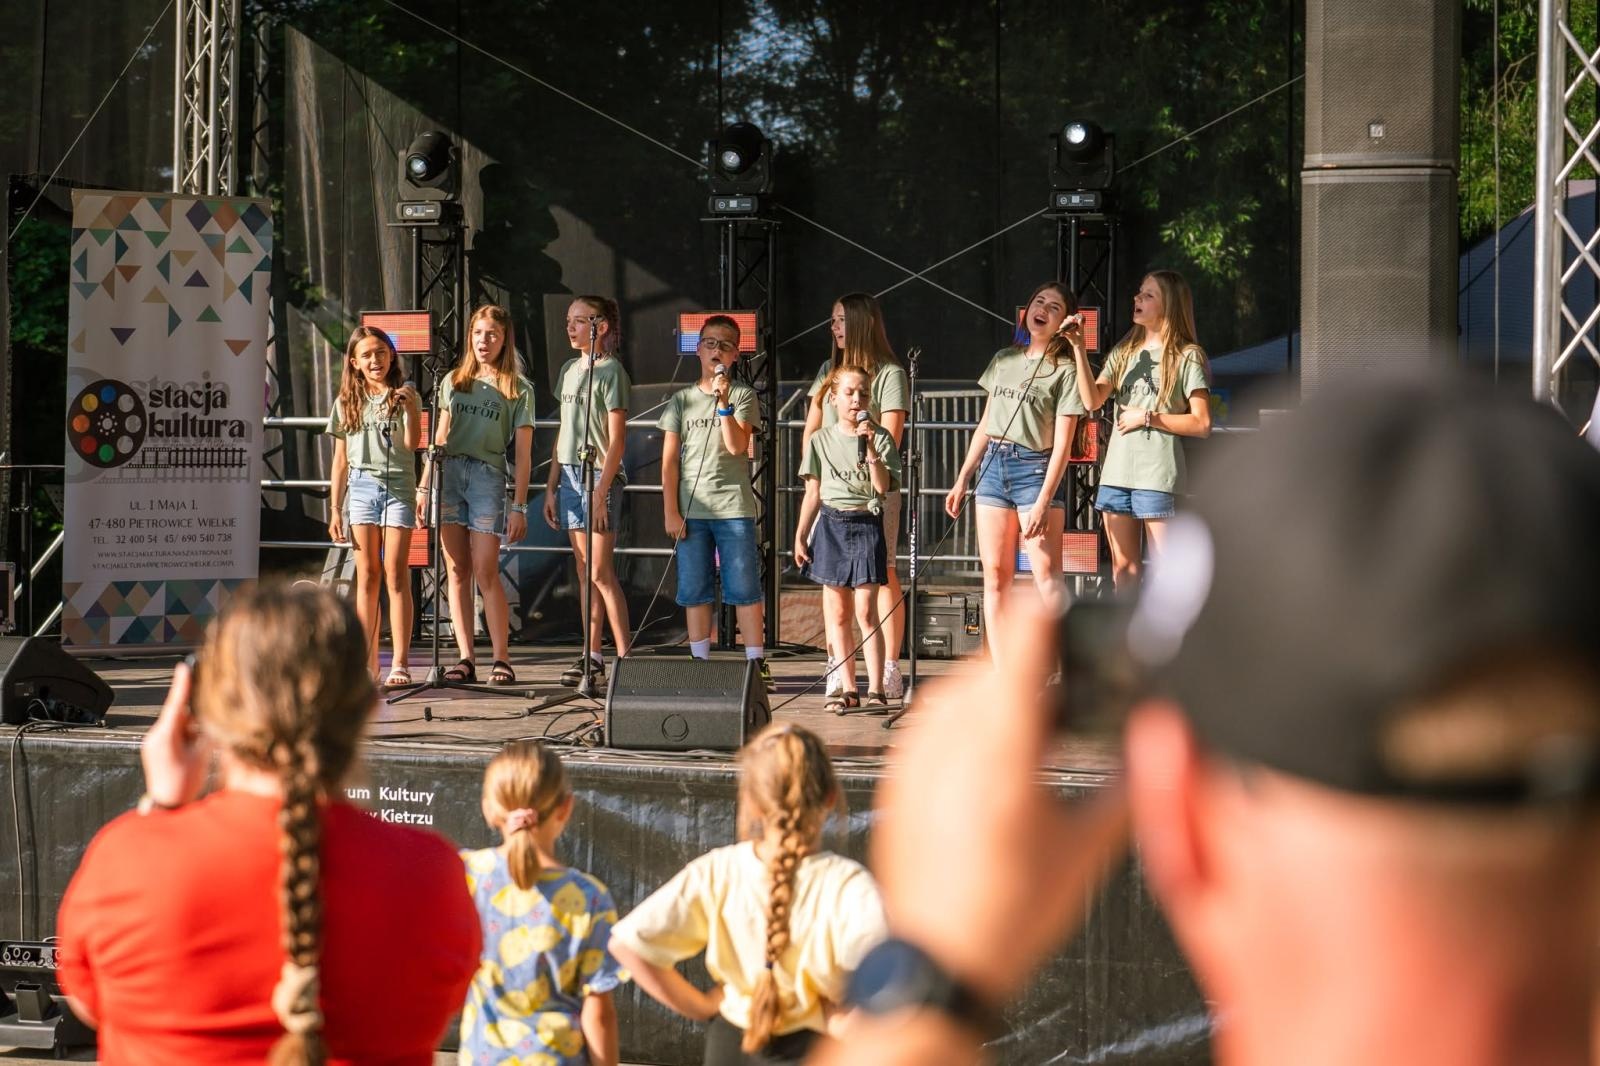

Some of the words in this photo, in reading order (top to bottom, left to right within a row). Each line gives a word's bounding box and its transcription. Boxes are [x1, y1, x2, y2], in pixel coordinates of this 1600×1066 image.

[149, 382, 227, 416] stacja
[457, 402, 500, 421] peron
[148, 412, 245, 437] kultura
[687, 417, 722, 431] pero
[88, 518, 126, 529] 47-480
[116, 535, 126, 543] 32
[129, 535, 145, 543] 400
[148, 535, 157, 543] 54
[182, 534, 197, 542] 690
[200, 533, 215, 542] 540
[218, 533, 232, 541] 738
[344, 787, 370, 799] um
[380, 787, 434, 805] Kultury
[381, 809, 433, 825] Kietrzu
